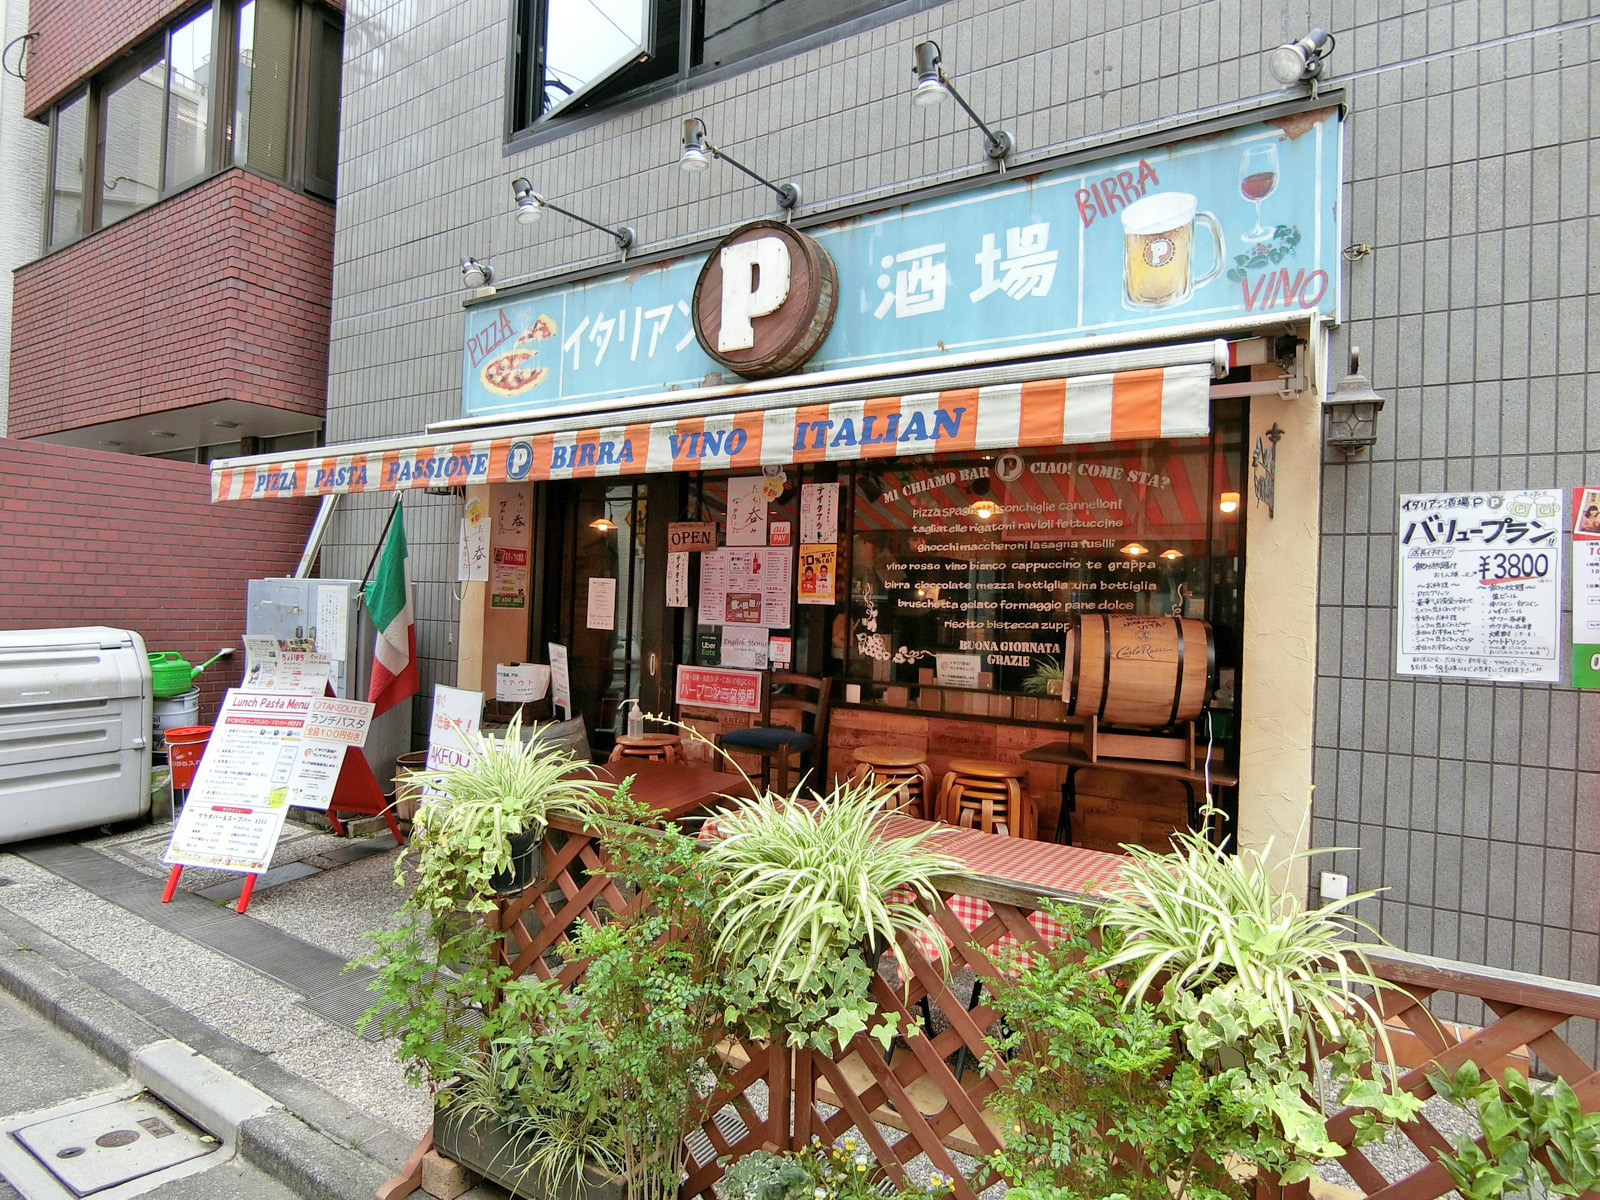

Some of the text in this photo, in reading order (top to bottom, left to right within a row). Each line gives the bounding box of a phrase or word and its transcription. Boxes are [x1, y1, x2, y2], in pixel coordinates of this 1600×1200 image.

[1074, 159, 1160, 228] BIRRA
[718, 236, 791, 353] P
[873, 222, 1059, 320] 酒場
[1241, 267, 1328, 312] VINO
[466, 307, 517, 368] PIZZA
[255, 407, 966, 493] PIZZA PASTA PASSIONE P BIRRA VINO ITALIAN
[883, 457, 1171, 503] MI CHIAMO BAR P CIAO! COME STA?
[912, 507, 941, 519] pizza
[1058, 499, 1122, 511] cannelloni
[912, 518, 1123, 535] tagliatelle rigatoni ravioli fettuccine
[671, 531, 711, 546] OPEN
[773, 534, 787, 542] PAY
[917, 539, 1115, 552] gnocchi maccheroni lasagna fusilli
[886, 562, 907, 570] vino
[945, 561, 967, 570] vino
[969, 560, 1007, 570] bianco
[1011, 560, 1081, 572] cappuccino
[1086, 560, 1102, 569] te
[1108, 561, 1156, 572] grappa
[1478, 553, 1549, 580] ¥3800
[884, 581, 911, 590] birra
[914, 581, 972, 590] cioccolate
[976, 582, 1015, 590] mezza
[1017, 580, 1068, 591] bottiglia
[1100, 580, 1157, 592] bottiglia
[897, 599, 1134, 612] bruschetta gelato formaggio pane dolce
[944, 620, 985, 629] risotto
[986, 620, 1039, 629] bistecca
[701, 641, 717, 649] Uber
[959, 640, 1060, 653] BUONA GIORNATA
[1116, 643, 1173, 659] Carlo Rossi
[986, 654, 1030, 667] GRAZIE
[232, 696, 311, 711] Lunch Pasta Menu
[321, 702, 358, 714] TAKEOUT
[310, 713, 366, 729] ランチパスタ
